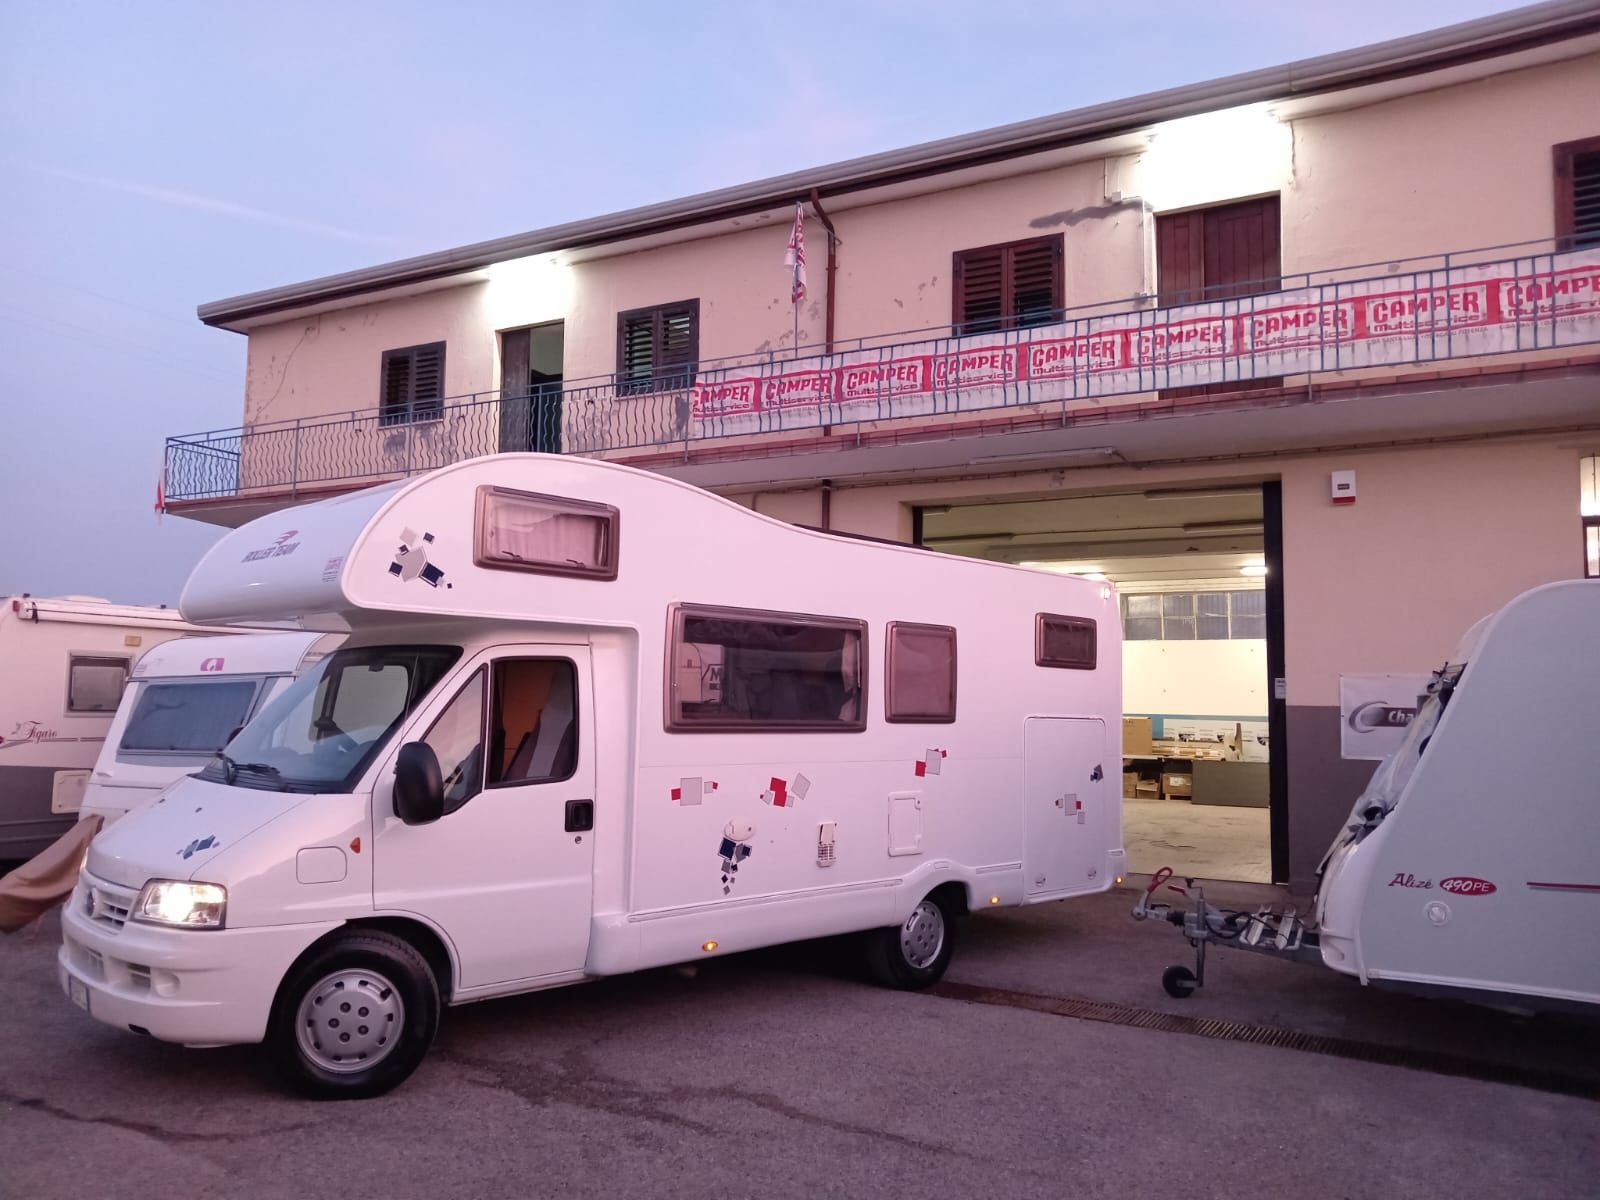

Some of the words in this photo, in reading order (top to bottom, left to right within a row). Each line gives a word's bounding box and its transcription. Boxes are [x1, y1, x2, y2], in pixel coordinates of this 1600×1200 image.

[1373, 291, 1480, 324] CAMPER
[1254, 308, 1348, 339] CAMPER
[1032, 340, 1115, 368] CAMPER
[1139, 325, 1224, 355] CAMPER
[847, 364, 918, 390] CAMPER
[936, 353, 1013, 380] CAMPER
[765, 376, 831, 400] CAMPER
